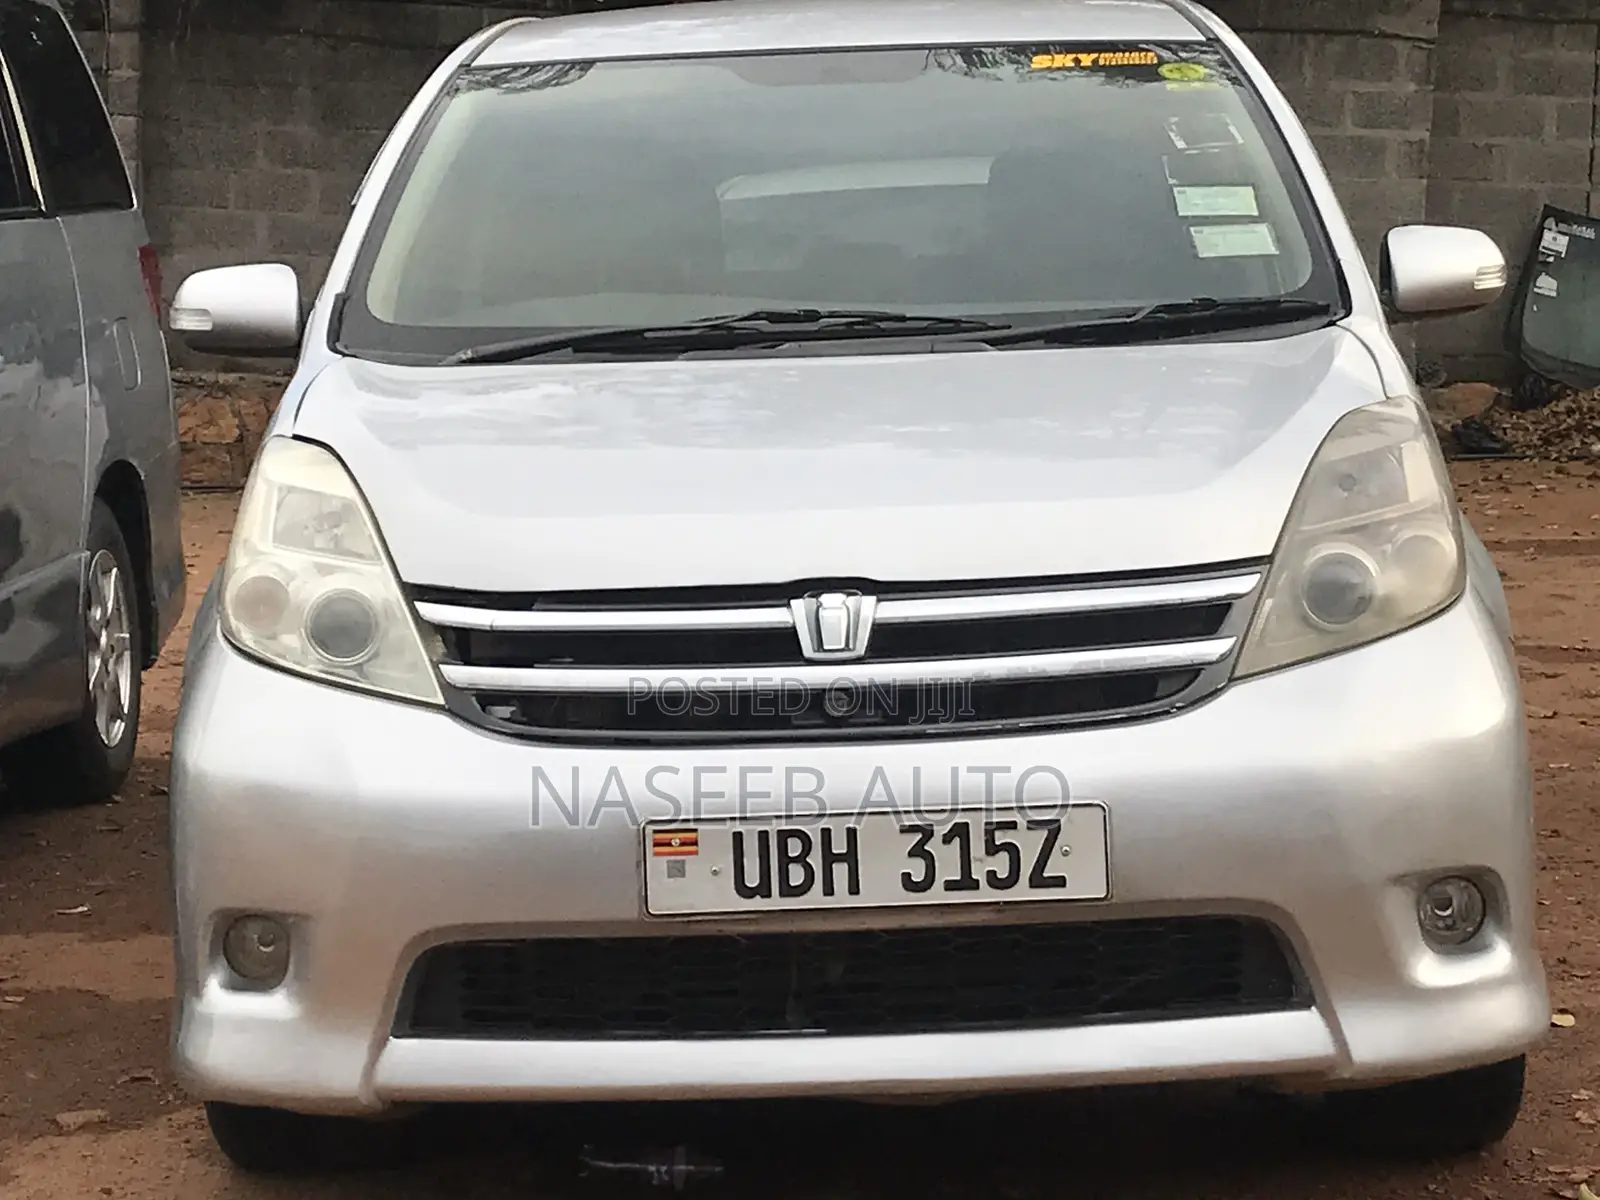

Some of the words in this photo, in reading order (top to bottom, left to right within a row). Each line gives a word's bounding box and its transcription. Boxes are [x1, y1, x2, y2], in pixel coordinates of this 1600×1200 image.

[1030, 53, 1099, 69] SKY
[731, 825, 861, 899] UBH
[899, 818, 1067, 893] 315Z
